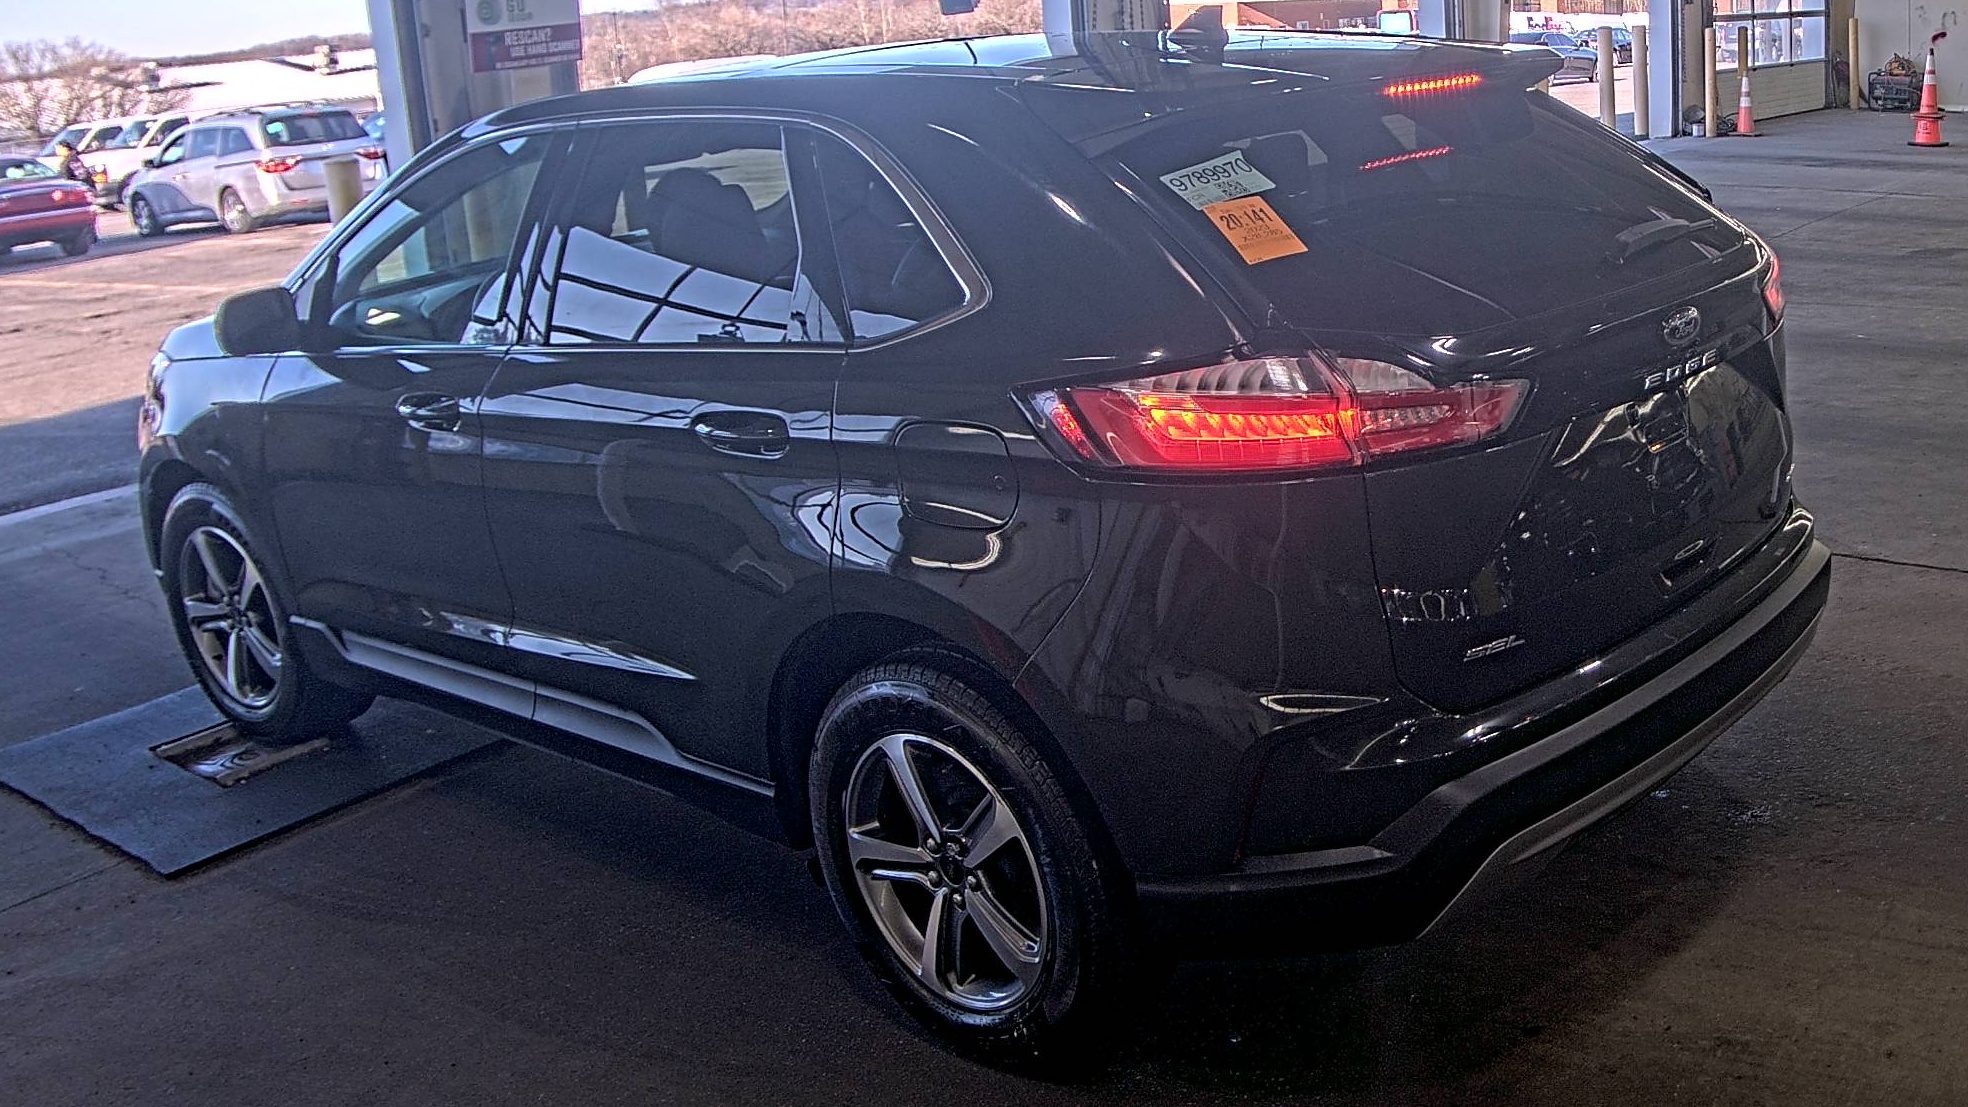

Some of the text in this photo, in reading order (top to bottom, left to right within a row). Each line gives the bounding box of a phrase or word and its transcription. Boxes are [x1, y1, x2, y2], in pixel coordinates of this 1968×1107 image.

[1169, 157, 1253, 192] 9789970
[1644, 348, 1717, 390] EDGE
[1463, 635, 1526, 661] SEL
